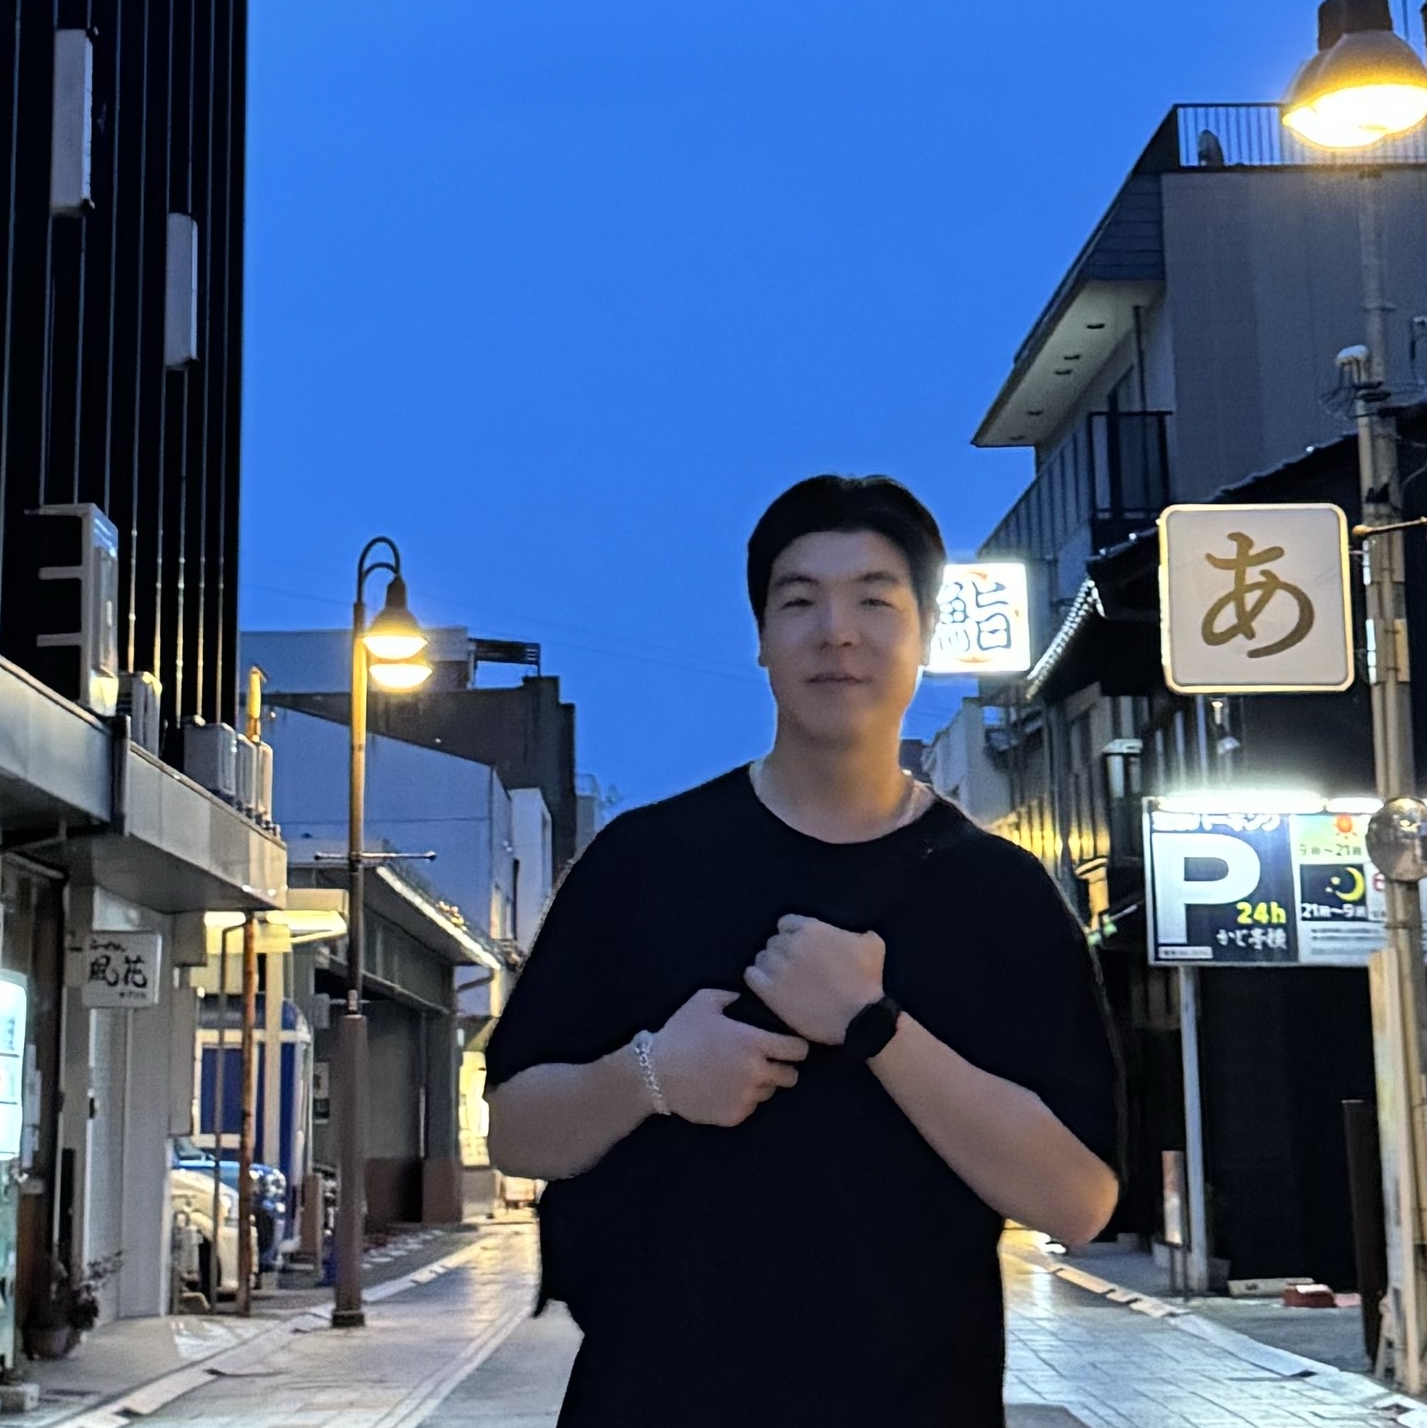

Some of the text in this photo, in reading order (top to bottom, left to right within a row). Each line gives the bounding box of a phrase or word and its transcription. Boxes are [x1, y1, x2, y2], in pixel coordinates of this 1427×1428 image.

[1202, 532, 1315, 658] あ
[1152, 832, 1261, 944] P
[1236, 901, 1287, 924] 24h
